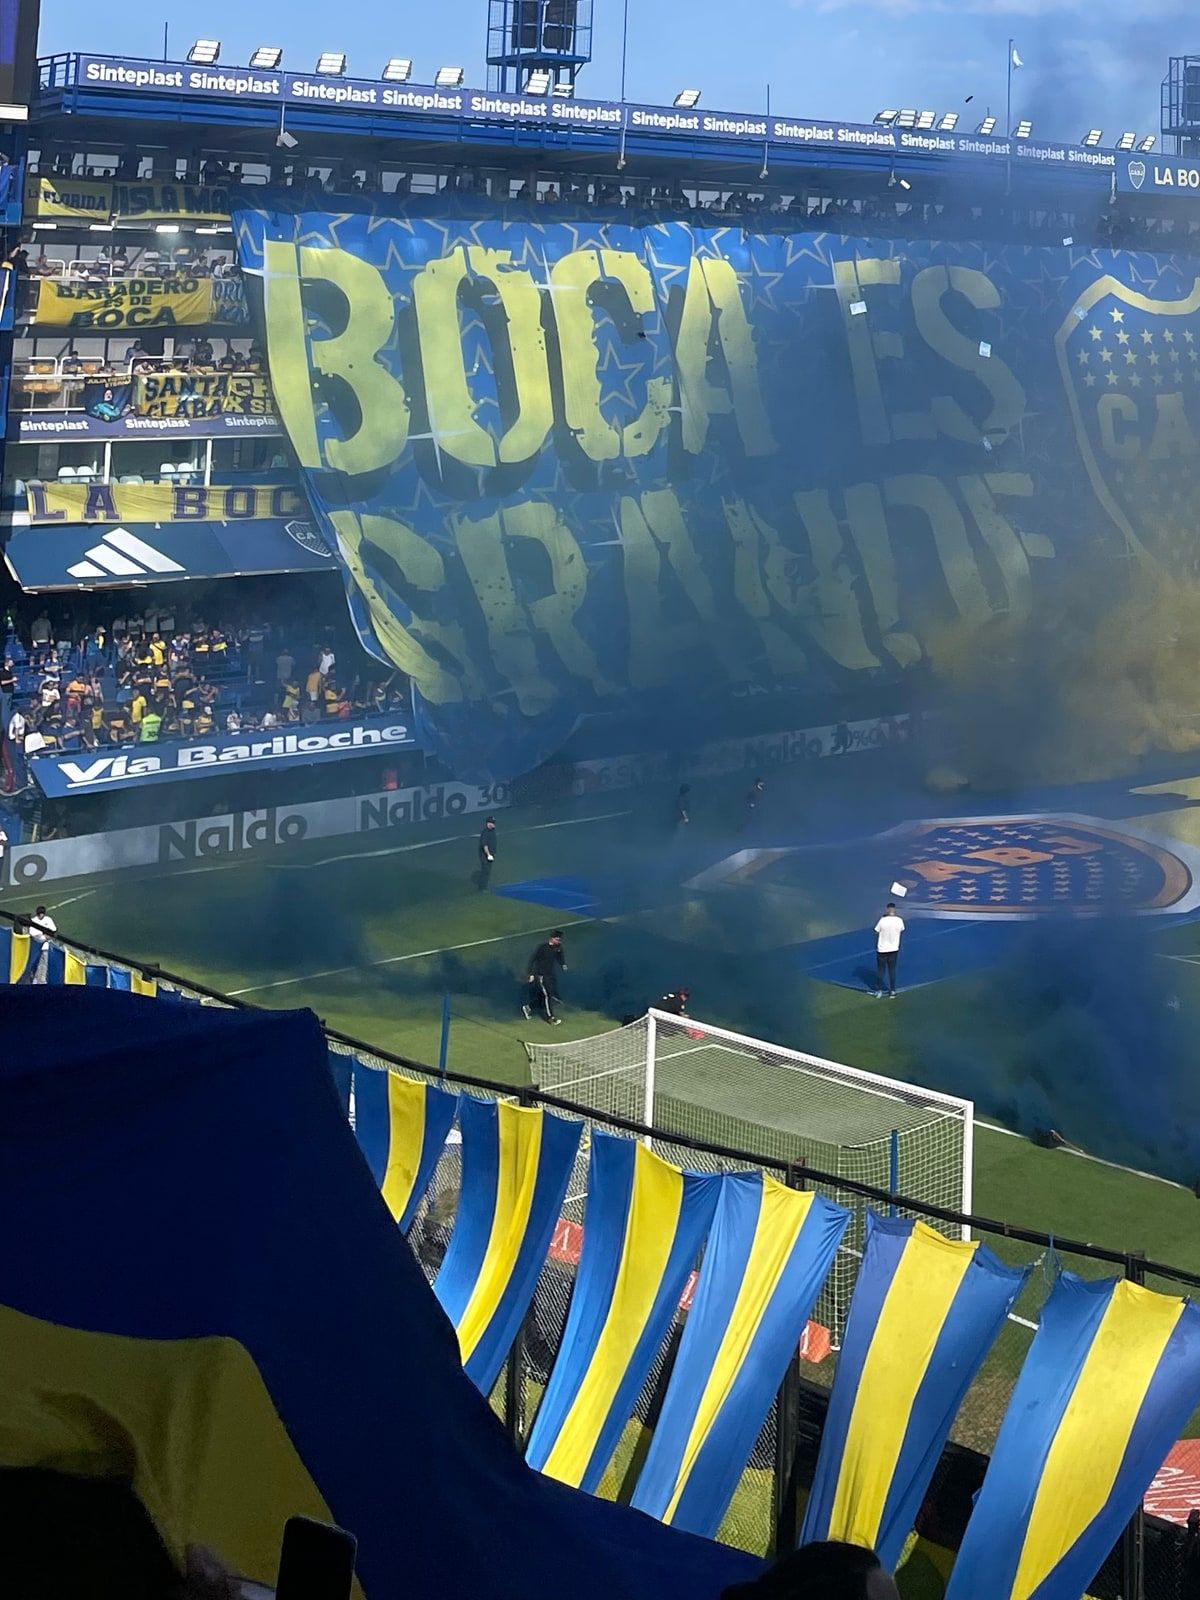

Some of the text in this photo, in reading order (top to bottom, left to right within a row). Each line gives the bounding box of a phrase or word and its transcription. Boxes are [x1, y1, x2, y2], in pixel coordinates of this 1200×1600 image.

[86, 63, 1116, 167] Sinteplast Sinteplast Sinteplast Sinteplast Sinteplast Sinteplast Sinteplast Sinteplast Sinteplast Sinteplast Sinteplast Sinteplast Sinteplast Sinteplast
[1154, 166, 1174, 186] LA
[56, 279, 200, 300] BARADERO
[129, 295, 152, 306] DE
[69, 306, 177, 328] BOCA
[264, 240, 1027, 476] BOCA ES
[145, 376, 226, 401] SANTA
[20, 420, 89, 432] Sinteplast
[125, 417, 191, 430] Sinteplast
[32, 485, 122, 521] LA
[177, 724, 408, 768] Bariloche
[359, 786, 467, 831] Naldo
[158, 807, 308, 863] Naldo
